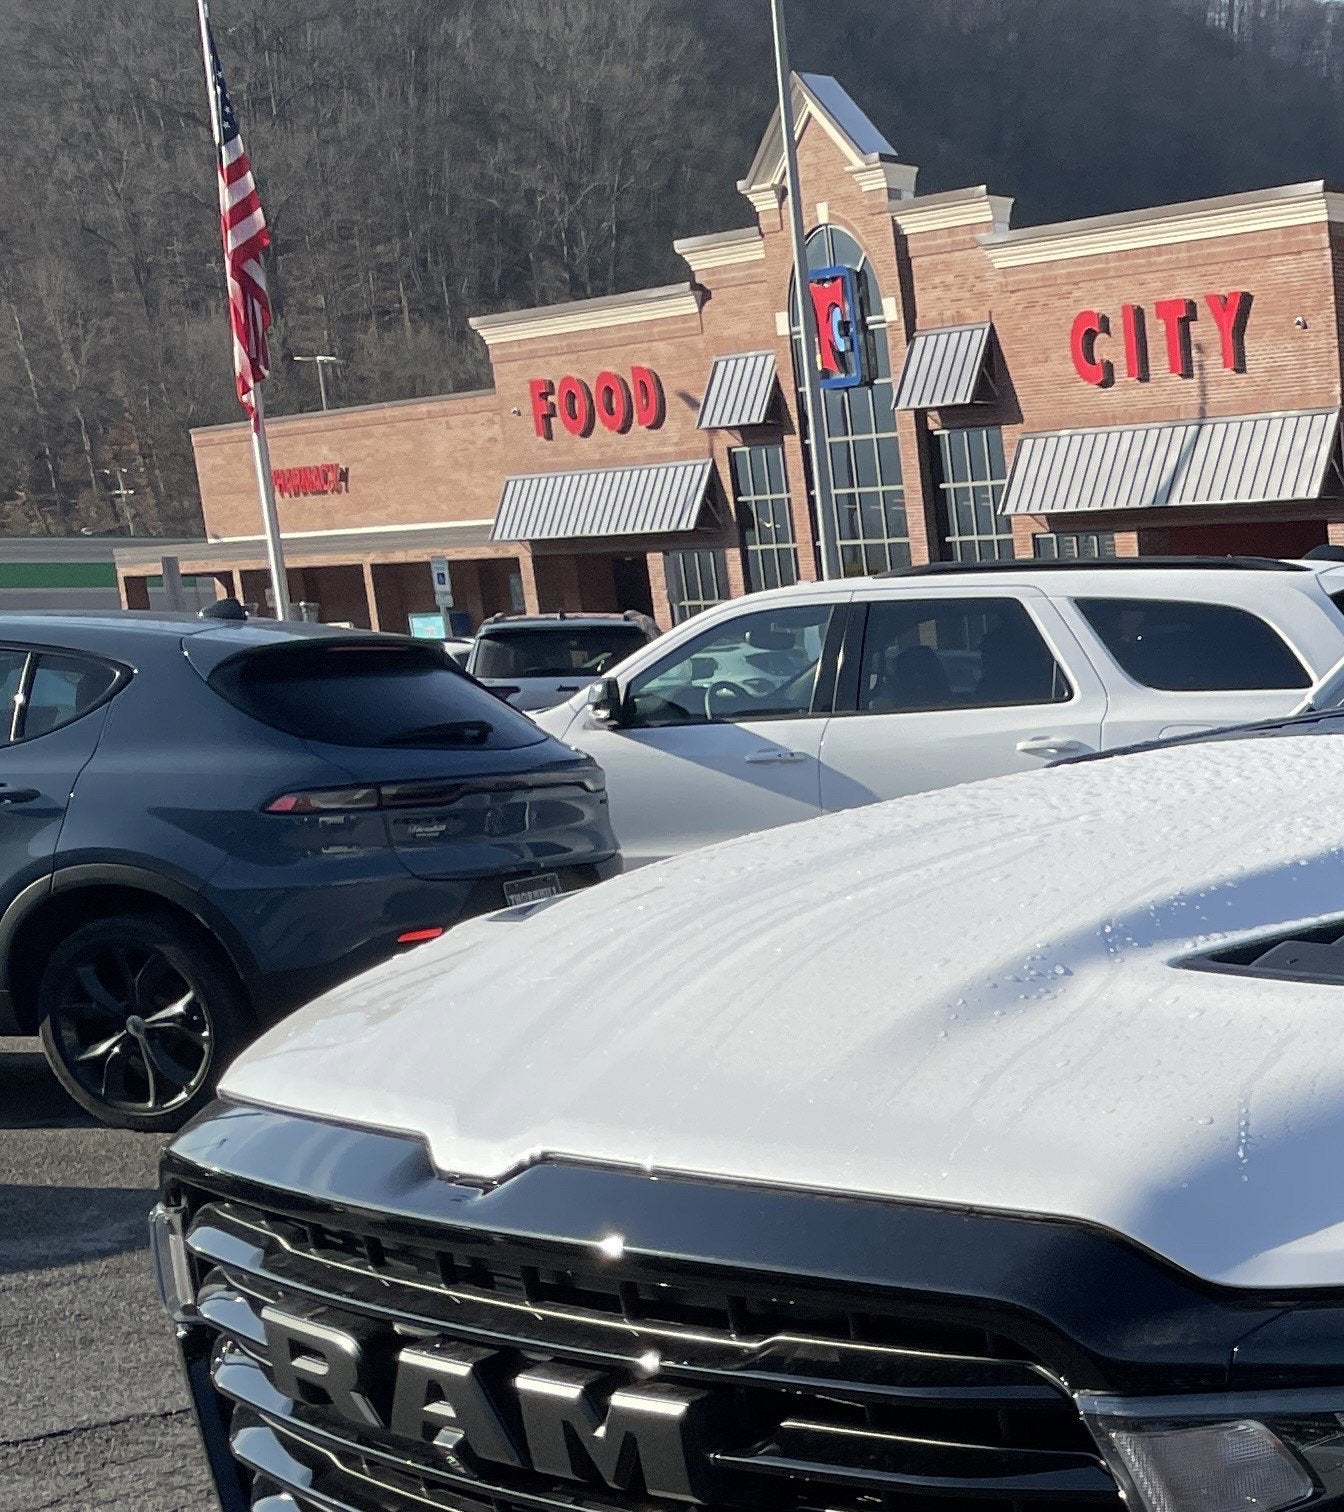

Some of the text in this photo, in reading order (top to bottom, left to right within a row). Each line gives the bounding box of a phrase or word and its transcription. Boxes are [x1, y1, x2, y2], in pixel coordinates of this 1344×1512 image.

[1070, 291, 1250, 388] CITY
[529, 364, 664, 440] FOOD
[261, 1304, 703, 1503] RAM
